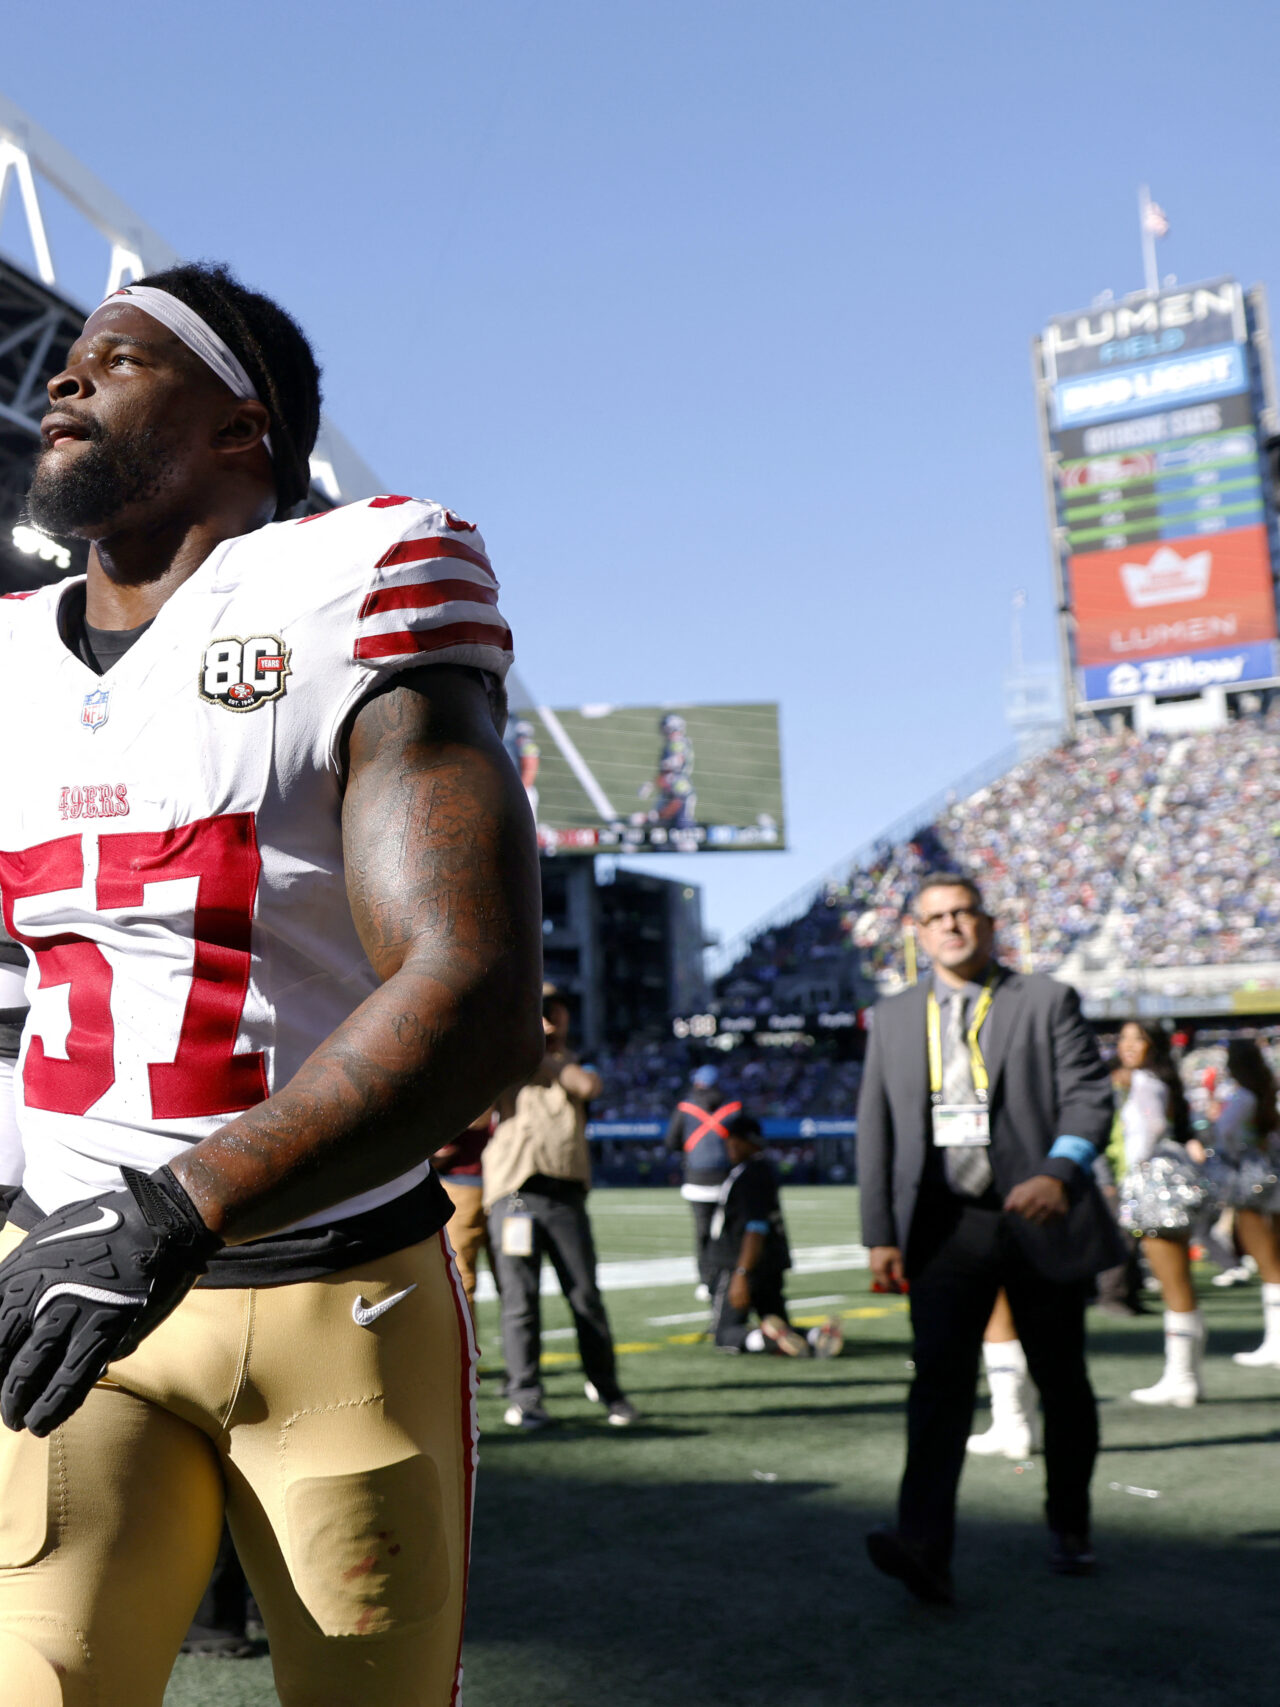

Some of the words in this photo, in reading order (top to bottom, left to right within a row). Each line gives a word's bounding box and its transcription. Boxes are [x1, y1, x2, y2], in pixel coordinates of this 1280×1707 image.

[1043, 284, 1234, 353] LUMEN
[1099, 328, 1186, 363] FIELD
[1110, 614, 1238, 653] LUMEN
[204, 637, 279, 695] 80
[261, 659, 280, 669] YEARS
[1141, 656, 1246, 693] Zillow
[83, 704, 104, 725] NFL
[58, 783, 130, 820] 49ERS
